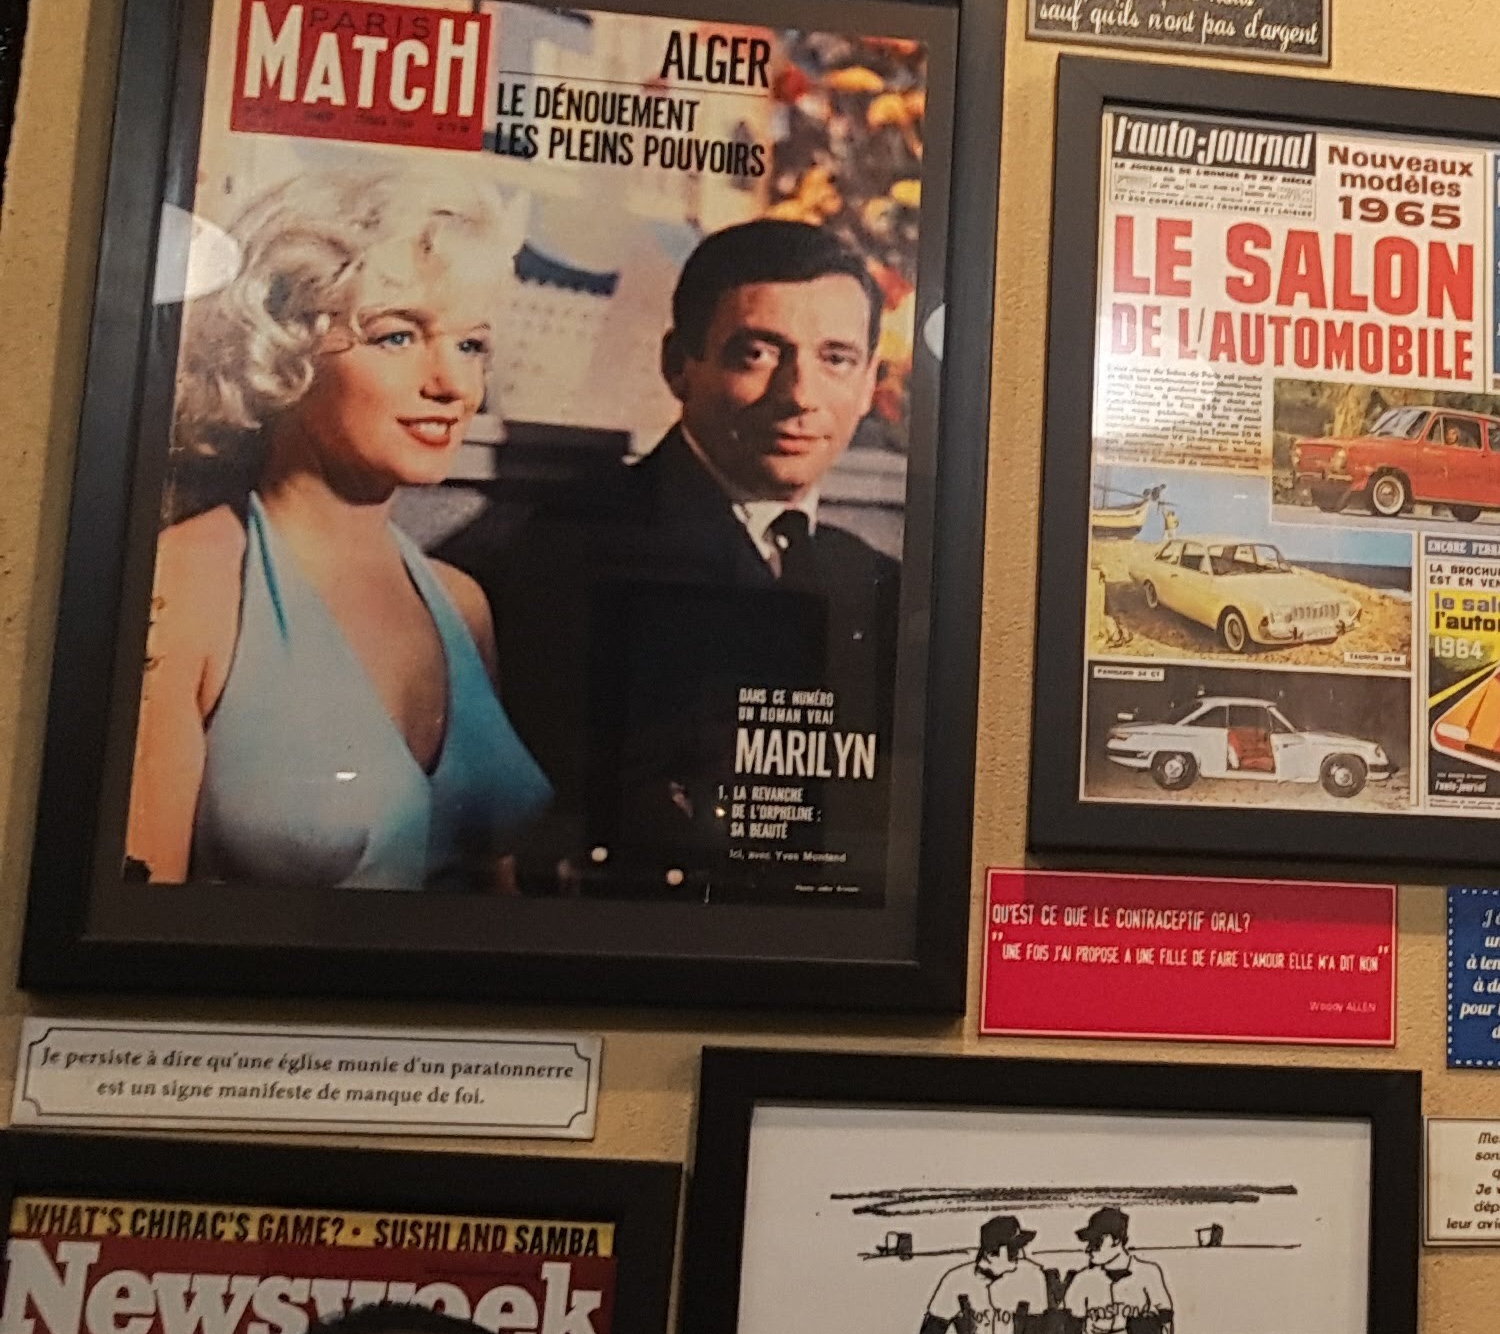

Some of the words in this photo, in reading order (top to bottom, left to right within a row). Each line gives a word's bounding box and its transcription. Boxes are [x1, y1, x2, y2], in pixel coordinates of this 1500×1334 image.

[309, 6, 432, 39] PARIS
[1148, 0, 1195, 33] n'ont
[1202, 11, 1236, 44] pas
[1244, 8, 1318, 53] d'argent
[243, 0, 479, 118] MATCH
[661, 29, 772, 89] ALGER
[496, 83, 525, 119] LE
[534, 82, 699, 133] DÉNOUEMENT
[495, 123, 538, 159] LES
[549, 129, 634, 167] PLEINS
[642, 138, 765, 178] POUVOIRS
[1327, 145, 1475, 179] Nouveaux
[1339, 171, 1462, 199] modèles
[1337, 195, 1462, 230] 1965
[1114, 214, 1194, 298] LE
[1225, 220, 1475, 322] SALON
[1112, 302, 1162, 359] DE
[1177, 306, 1475, 382] L'AUTOMOBILE
[1434, 594, 1456, 612] le
[1432, 635, 1485, 662] 1964
[735, 727, 876, 780] MARILYN
[992, 904, 1035, 926] QU'EST
[1040, 906, 1058, 925] CE
[1064, 907, 1088, 927] QUE
[1094, 909, 1109, 929] LE
[1116, 910, 1205, 932] CONTRACEPTIF
[1211, 913, 1251, 933] ORAL?
[41, 1047, 61, 1069] Je
[65, 1049, 142, 1071] persiste
[146, 1049, 158, 1067] à
[163, 1049, 200, 1068] dire
[207, 1051, 273, 1075] qu'une
[278, 1052, 333, 1076] église
[338, 1055, 398, 1075] munie
[404, 1057, 445, 1077] d'un
[451, 1059, 574, 1081] paratonnerre
[24, 1202, 124, 1238] WHAT'S
[129, 1208, 250, 1242] CHIRAC'S
[257, 1212, 345, 1246] GAME?
[374, 1220, 451, 1253] SUSHI
[456, 1223, 506, 1254] AND
[514, 1225, 600, 1258] SAMBA
